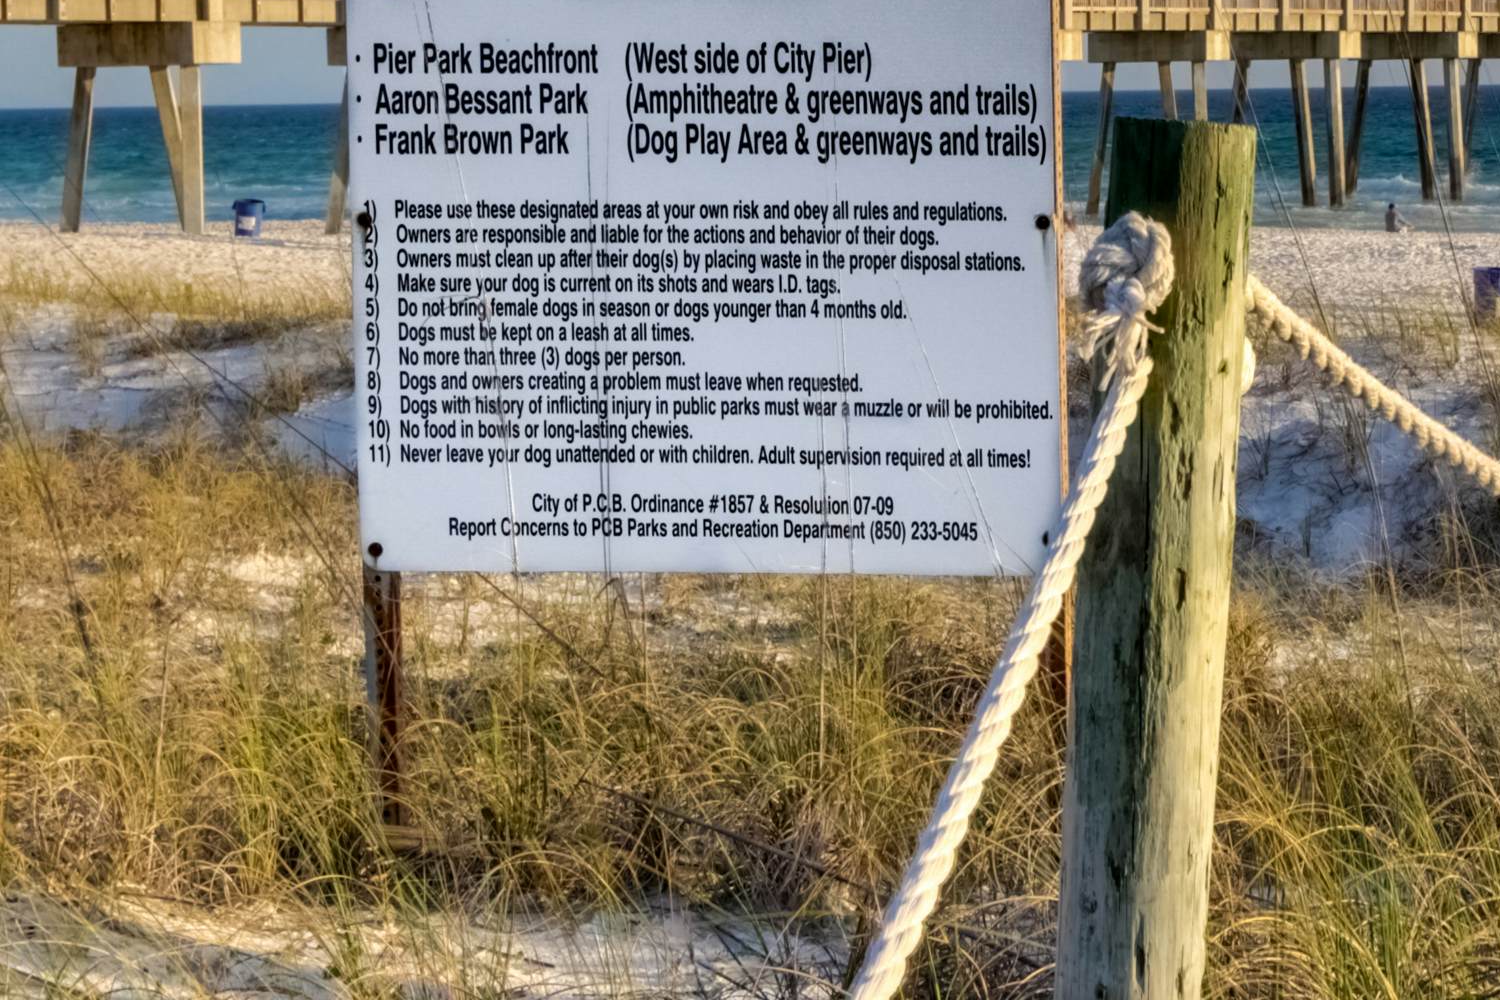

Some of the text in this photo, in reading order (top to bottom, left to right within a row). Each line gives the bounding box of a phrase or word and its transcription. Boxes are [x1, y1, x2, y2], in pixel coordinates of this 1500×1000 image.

[374, 42, 598, 74] Pier Park Beachfront
[626, 41, 871, 80] (West side of City Pier)
[376, 84, 588, 114] Aaron Bessant Park
[627, 84, 1037, 122] (Amphitheatre & greenways and trails)
[376, 125, 569, 155] Frank Brown Park
[628, 124, 1046, 164] (Dog Play Area & greenways and trails)
[395, 199, 1006, 223] Please use these designated areas at your own risk and obey all rules and regulations.
[397, 248, 1024, 272] Owners must clean up after their dog(s) by placing waste in the proper disposal stations.
[365, 272, 840, 296] 4) Make sure your dog is current on its shots and wears I.D. tags.
[366, 297, 906, 320] 5) Do not female dogs in season or dogs younger than 4 months old.
[366, 321, 693, 344] 6) Dogs must be kept on a leash at all times.
[367, 345, 685, 369] 7) No more than three (3) dogs per person.
[370, 443, 1030, 469] 11) Never leave dog unattended or with children. Adult supervision required at all times!
[533, 494, 893, 515] City of Ordinance #1857 & 07-09
[449, 517, 977, 543] Report Concerns to PCB Parks and Recreation Department (850) 233-5045
